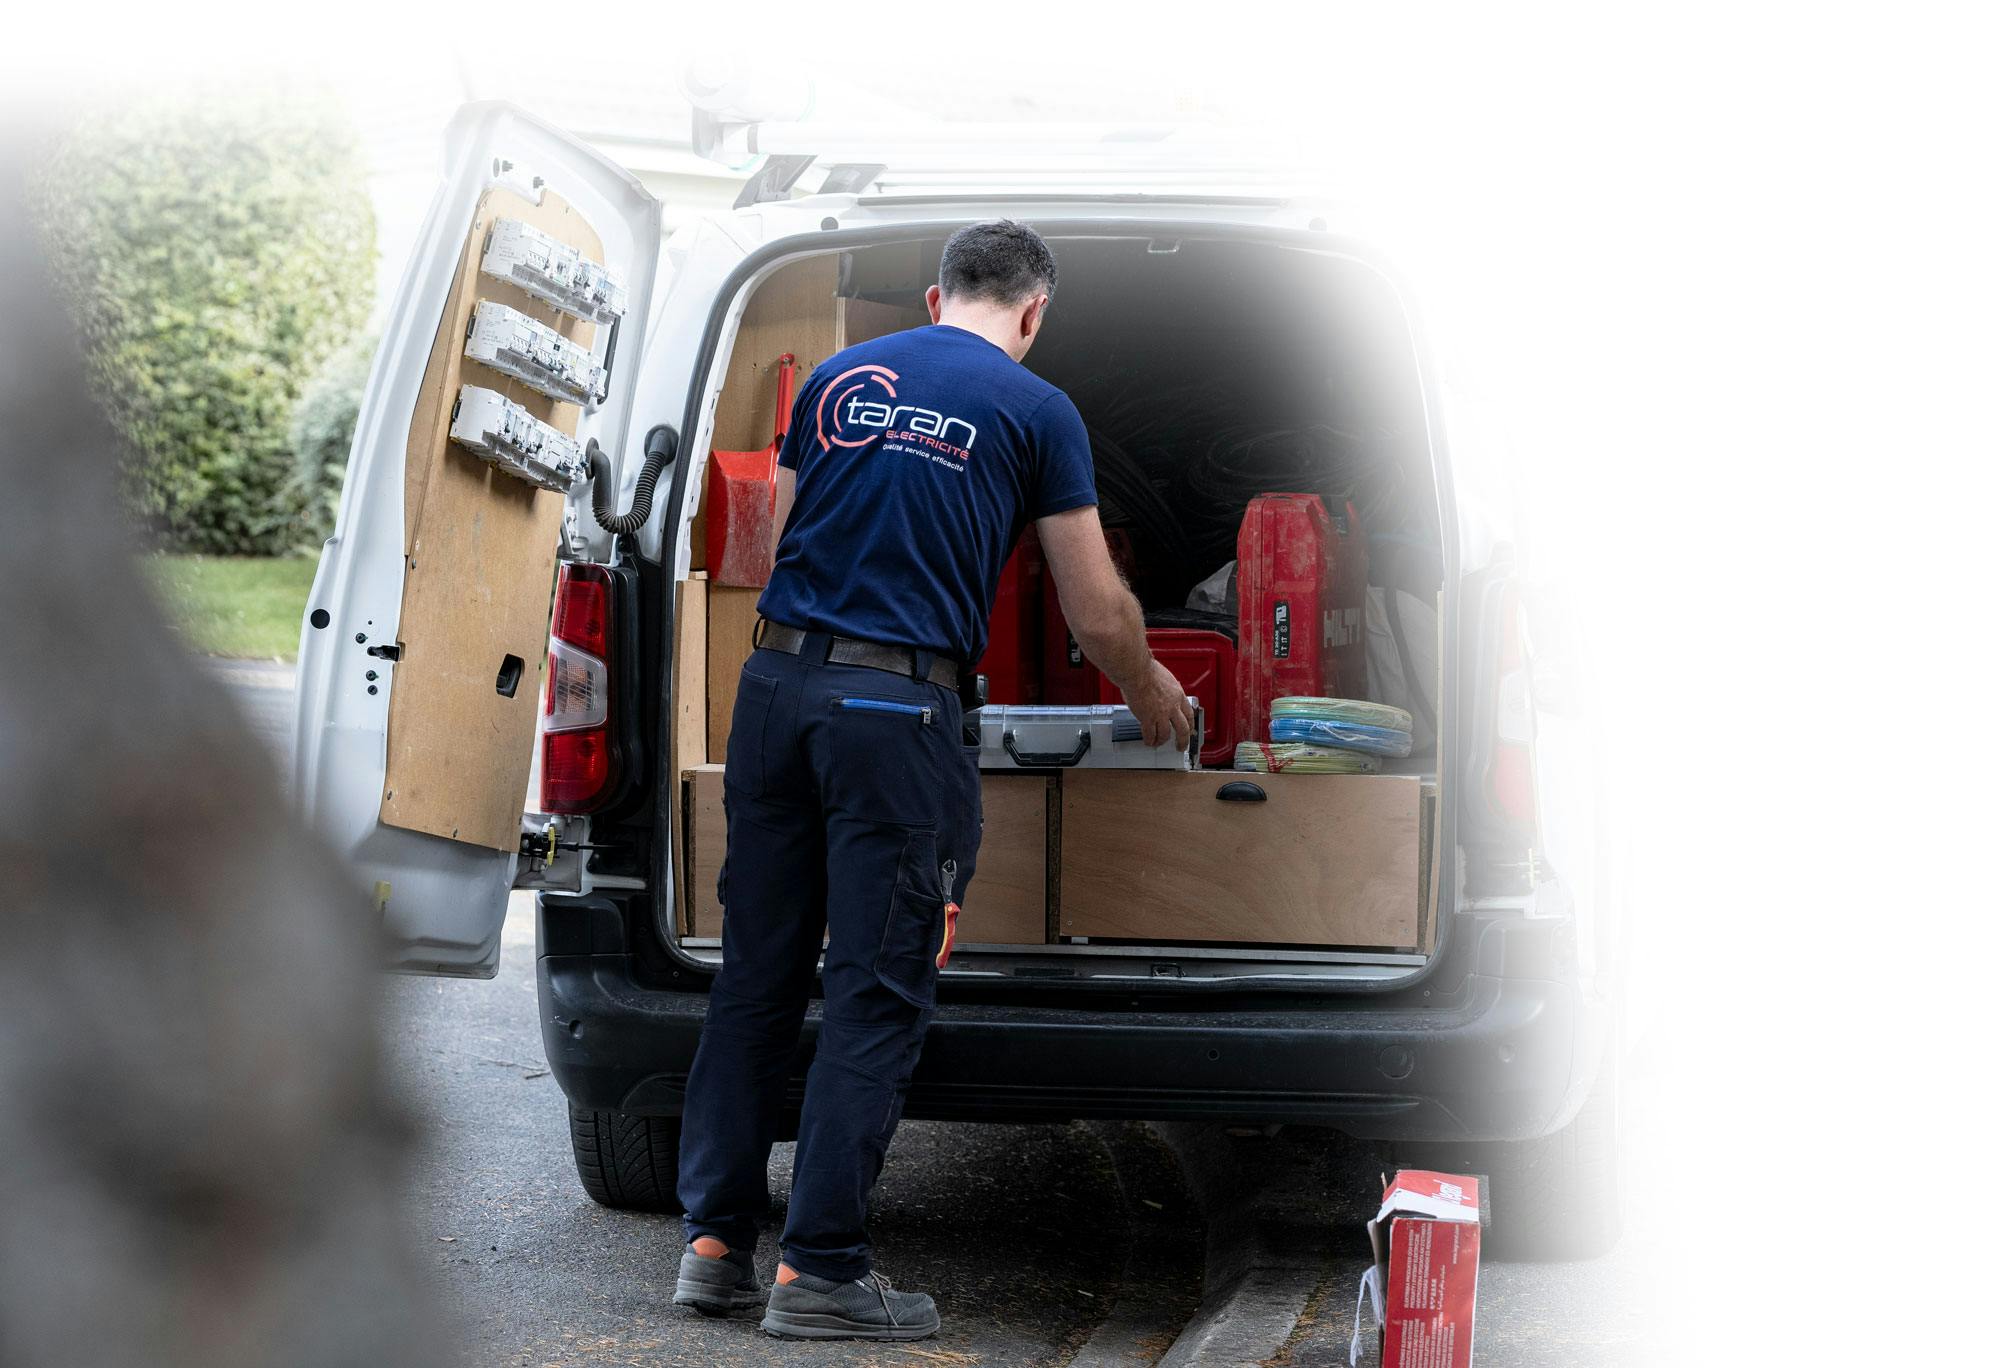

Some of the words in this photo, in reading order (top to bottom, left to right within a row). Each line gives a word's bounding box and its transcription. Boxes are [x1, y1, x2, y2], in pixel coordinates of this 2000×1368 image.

[847, 396, 977, 450] taran
[885, 429, 970, 461] ELECTRICITÉ
[904, 447, 930, 459] service
[931, 455, 964, 473] efficacité
[1323, 607, 1361, 649] HILTI
